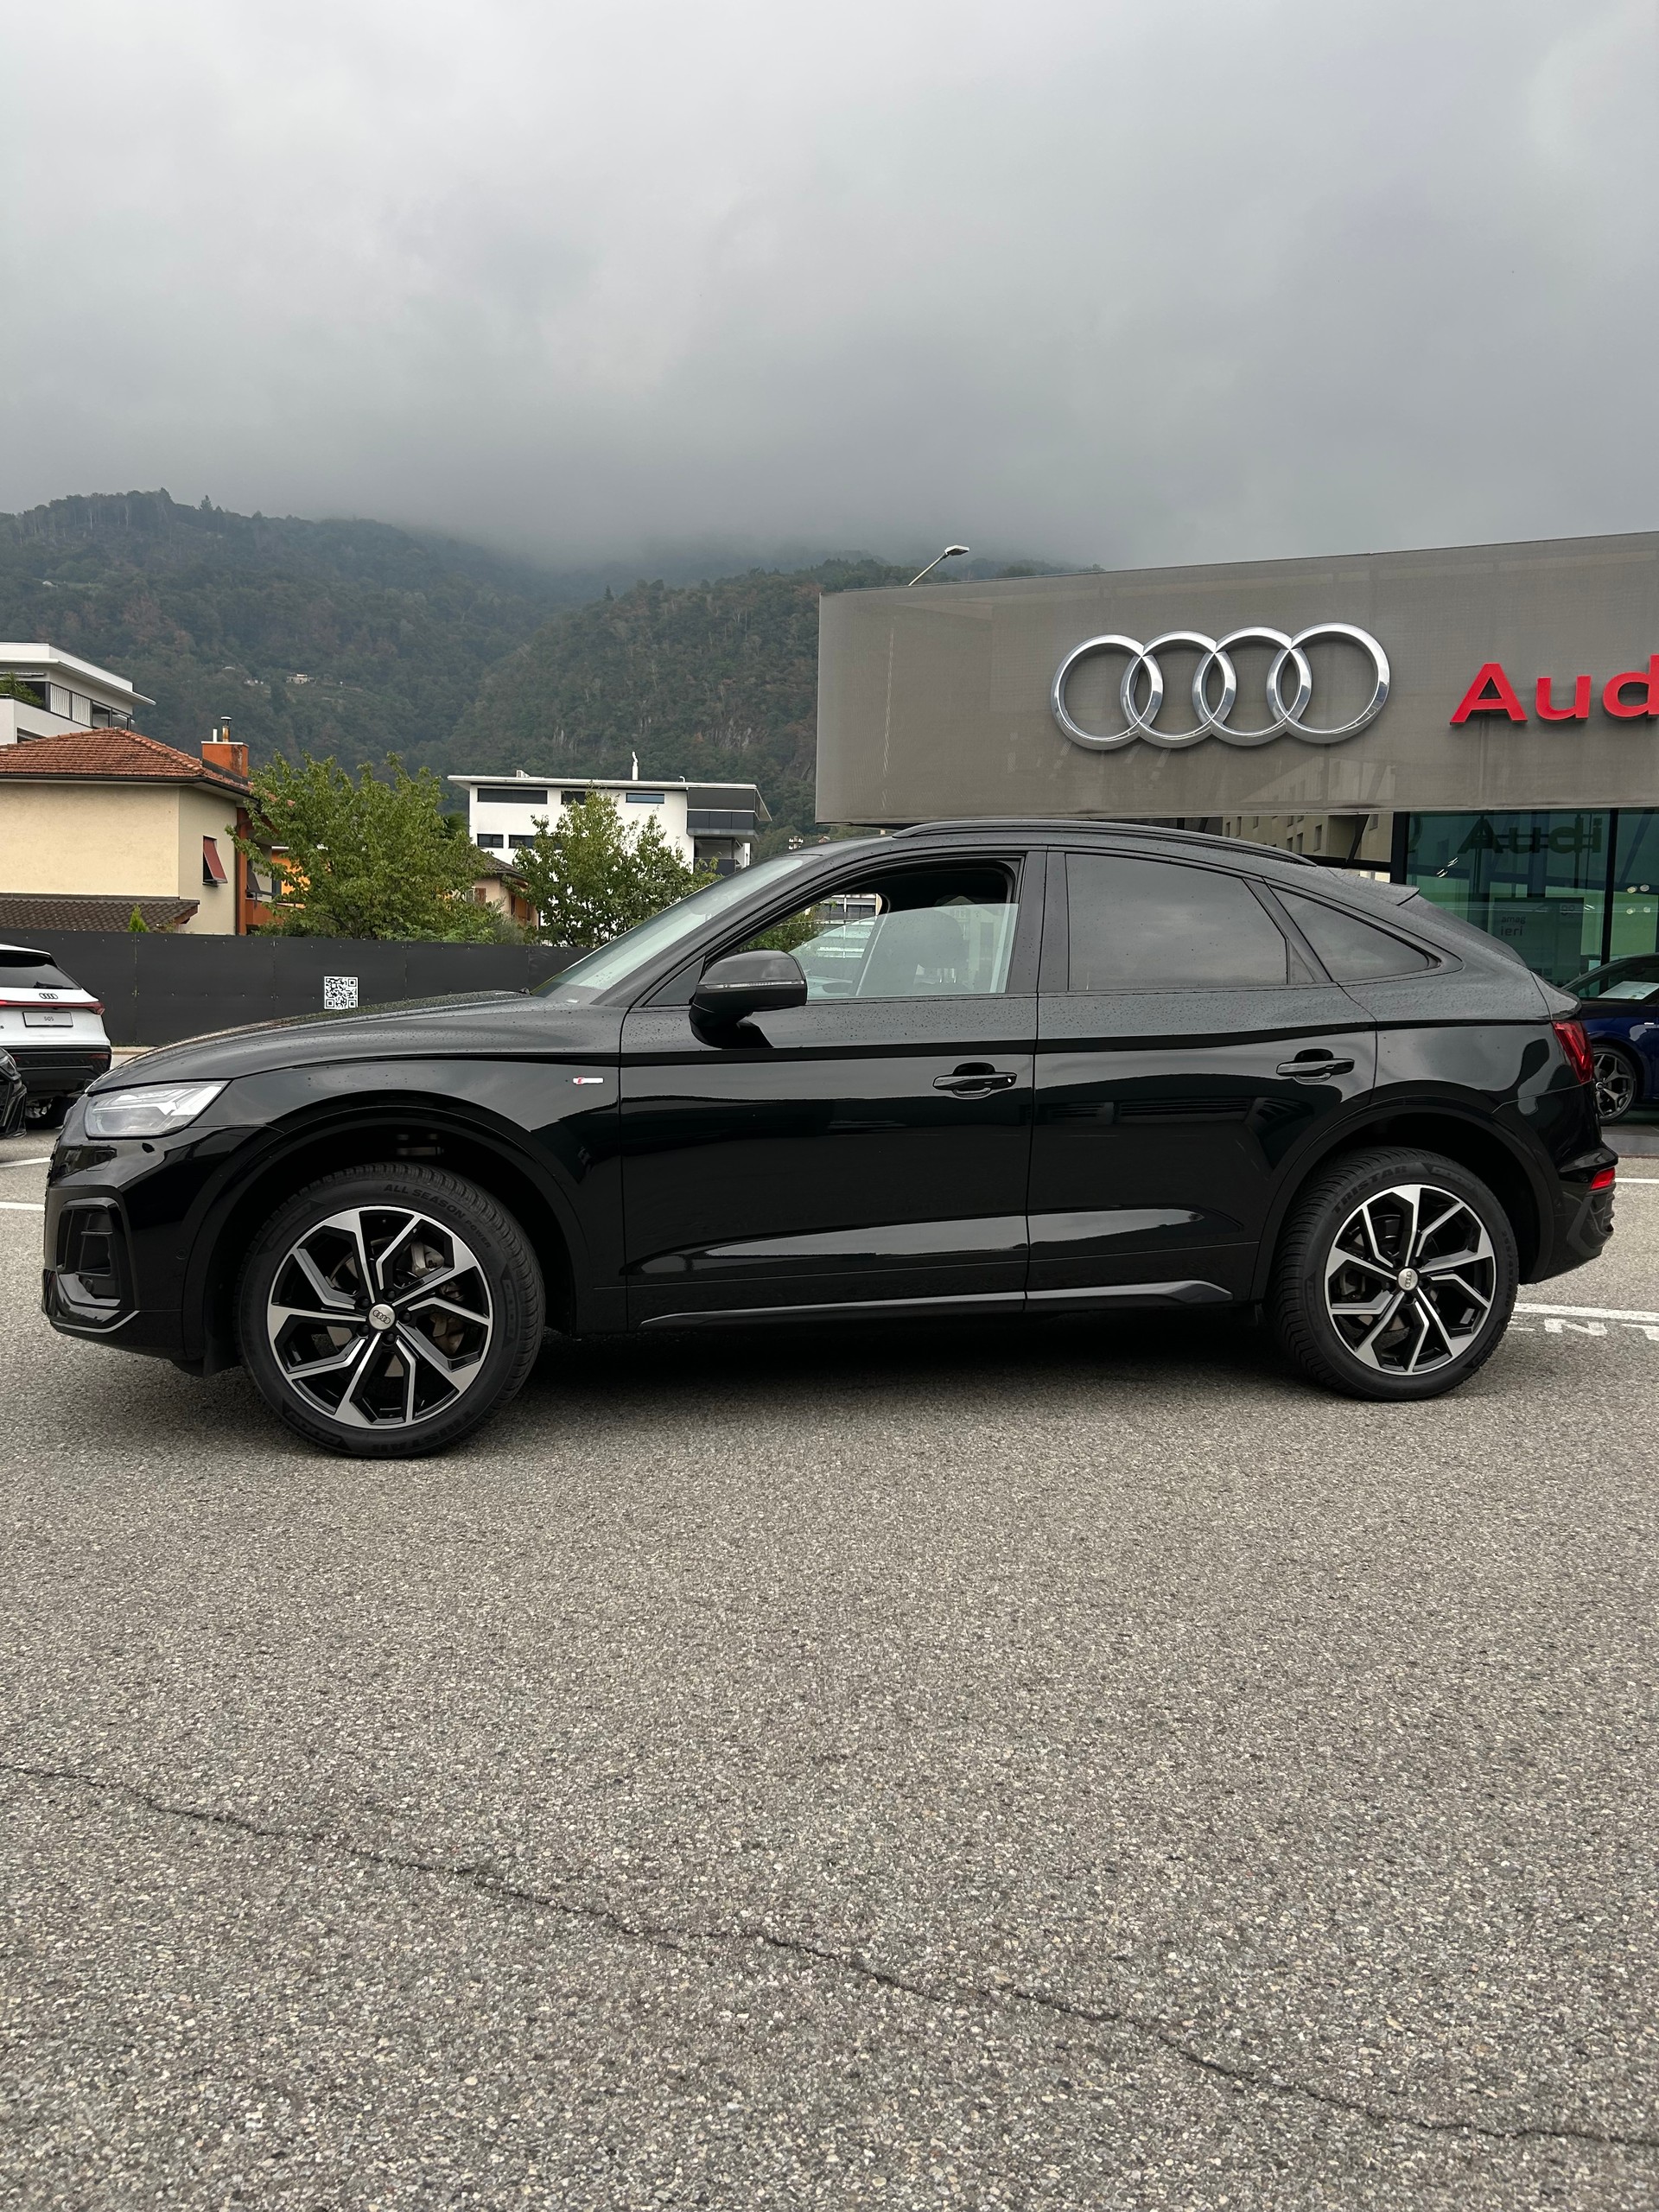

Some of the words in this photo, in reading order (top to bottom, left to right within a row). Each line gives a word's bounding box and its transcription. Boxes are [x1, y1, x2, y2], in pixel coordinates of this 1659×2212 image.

[1457, 817, 1602, 854] Audi
[1500, 925, 1523, 937] ieri
[1501, 916, 1527, 925] amag
[1332, 1166, 1407, 1214] TRISTAR
[384, 1184, 409, 1194] ALL
[412, 1189, 466, 1219] SEASON
[466, 1219, 492, 1249] POWER
